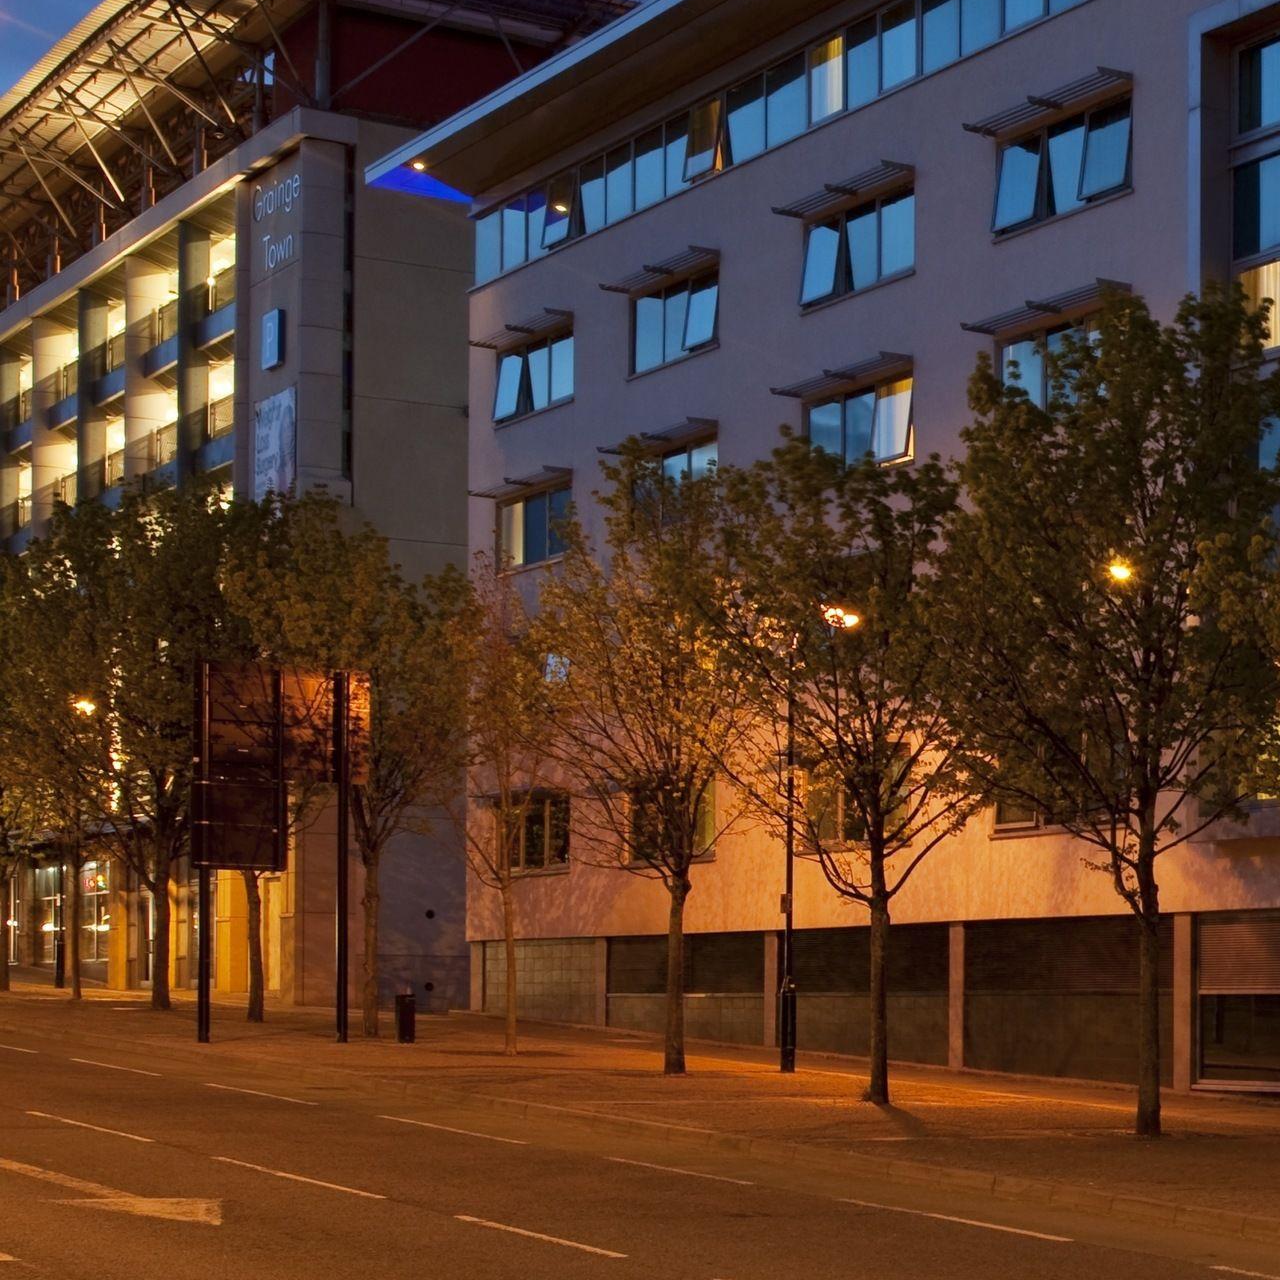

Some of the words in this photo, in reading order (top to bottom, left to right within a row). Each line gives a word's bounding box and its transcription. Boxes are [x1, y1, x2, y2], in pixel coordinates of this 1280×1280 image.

[253, 174, 301, 222] Grainge
[263, 234, 293, 271] Town
[266, 322, 274, 358] P
